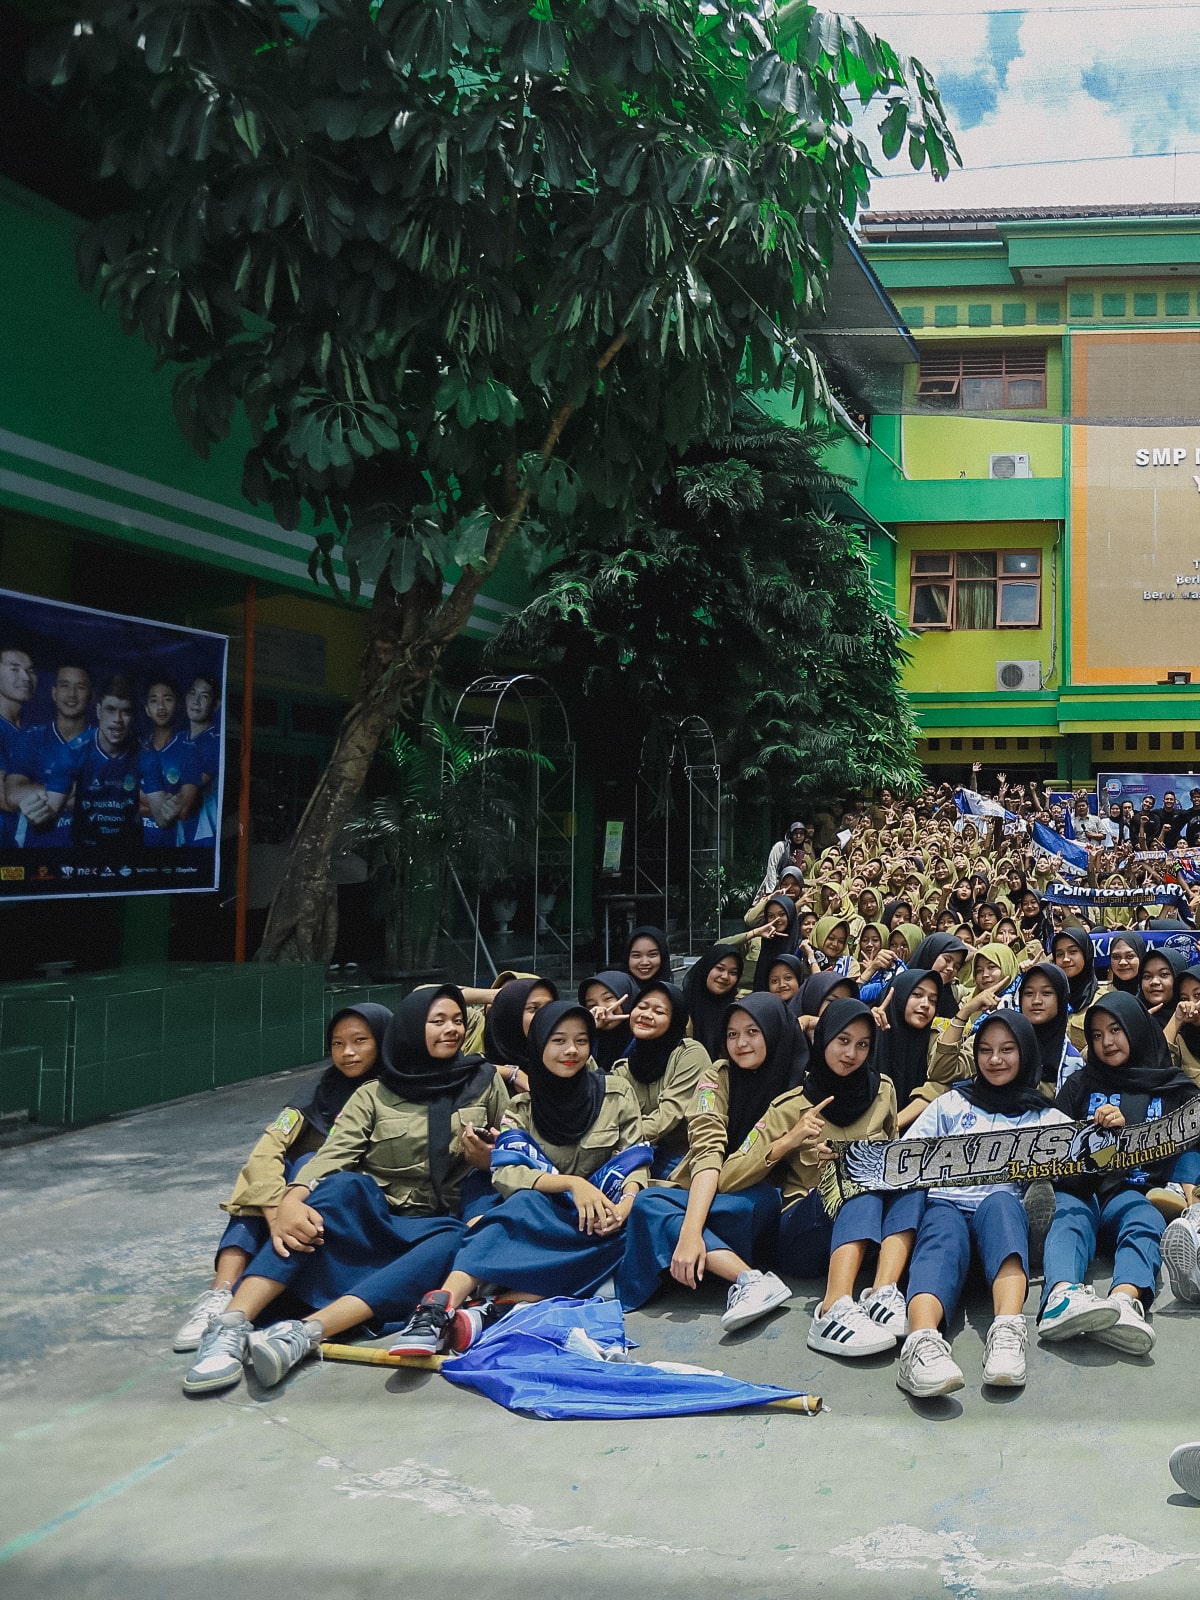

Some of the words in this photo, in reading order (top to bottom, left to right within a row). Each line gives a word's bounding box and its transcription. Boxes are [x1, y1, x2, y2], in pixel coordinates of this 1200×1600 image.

[1135, 448, 1187, 467] SMP
[1053, 883, 1092, 897] PSIM
[884, 1126, 1075, 1187] GADIS
[1008, 1157, 1087, 1181] Laskar
[1109, 1140, 1176, 1171] Mataram
